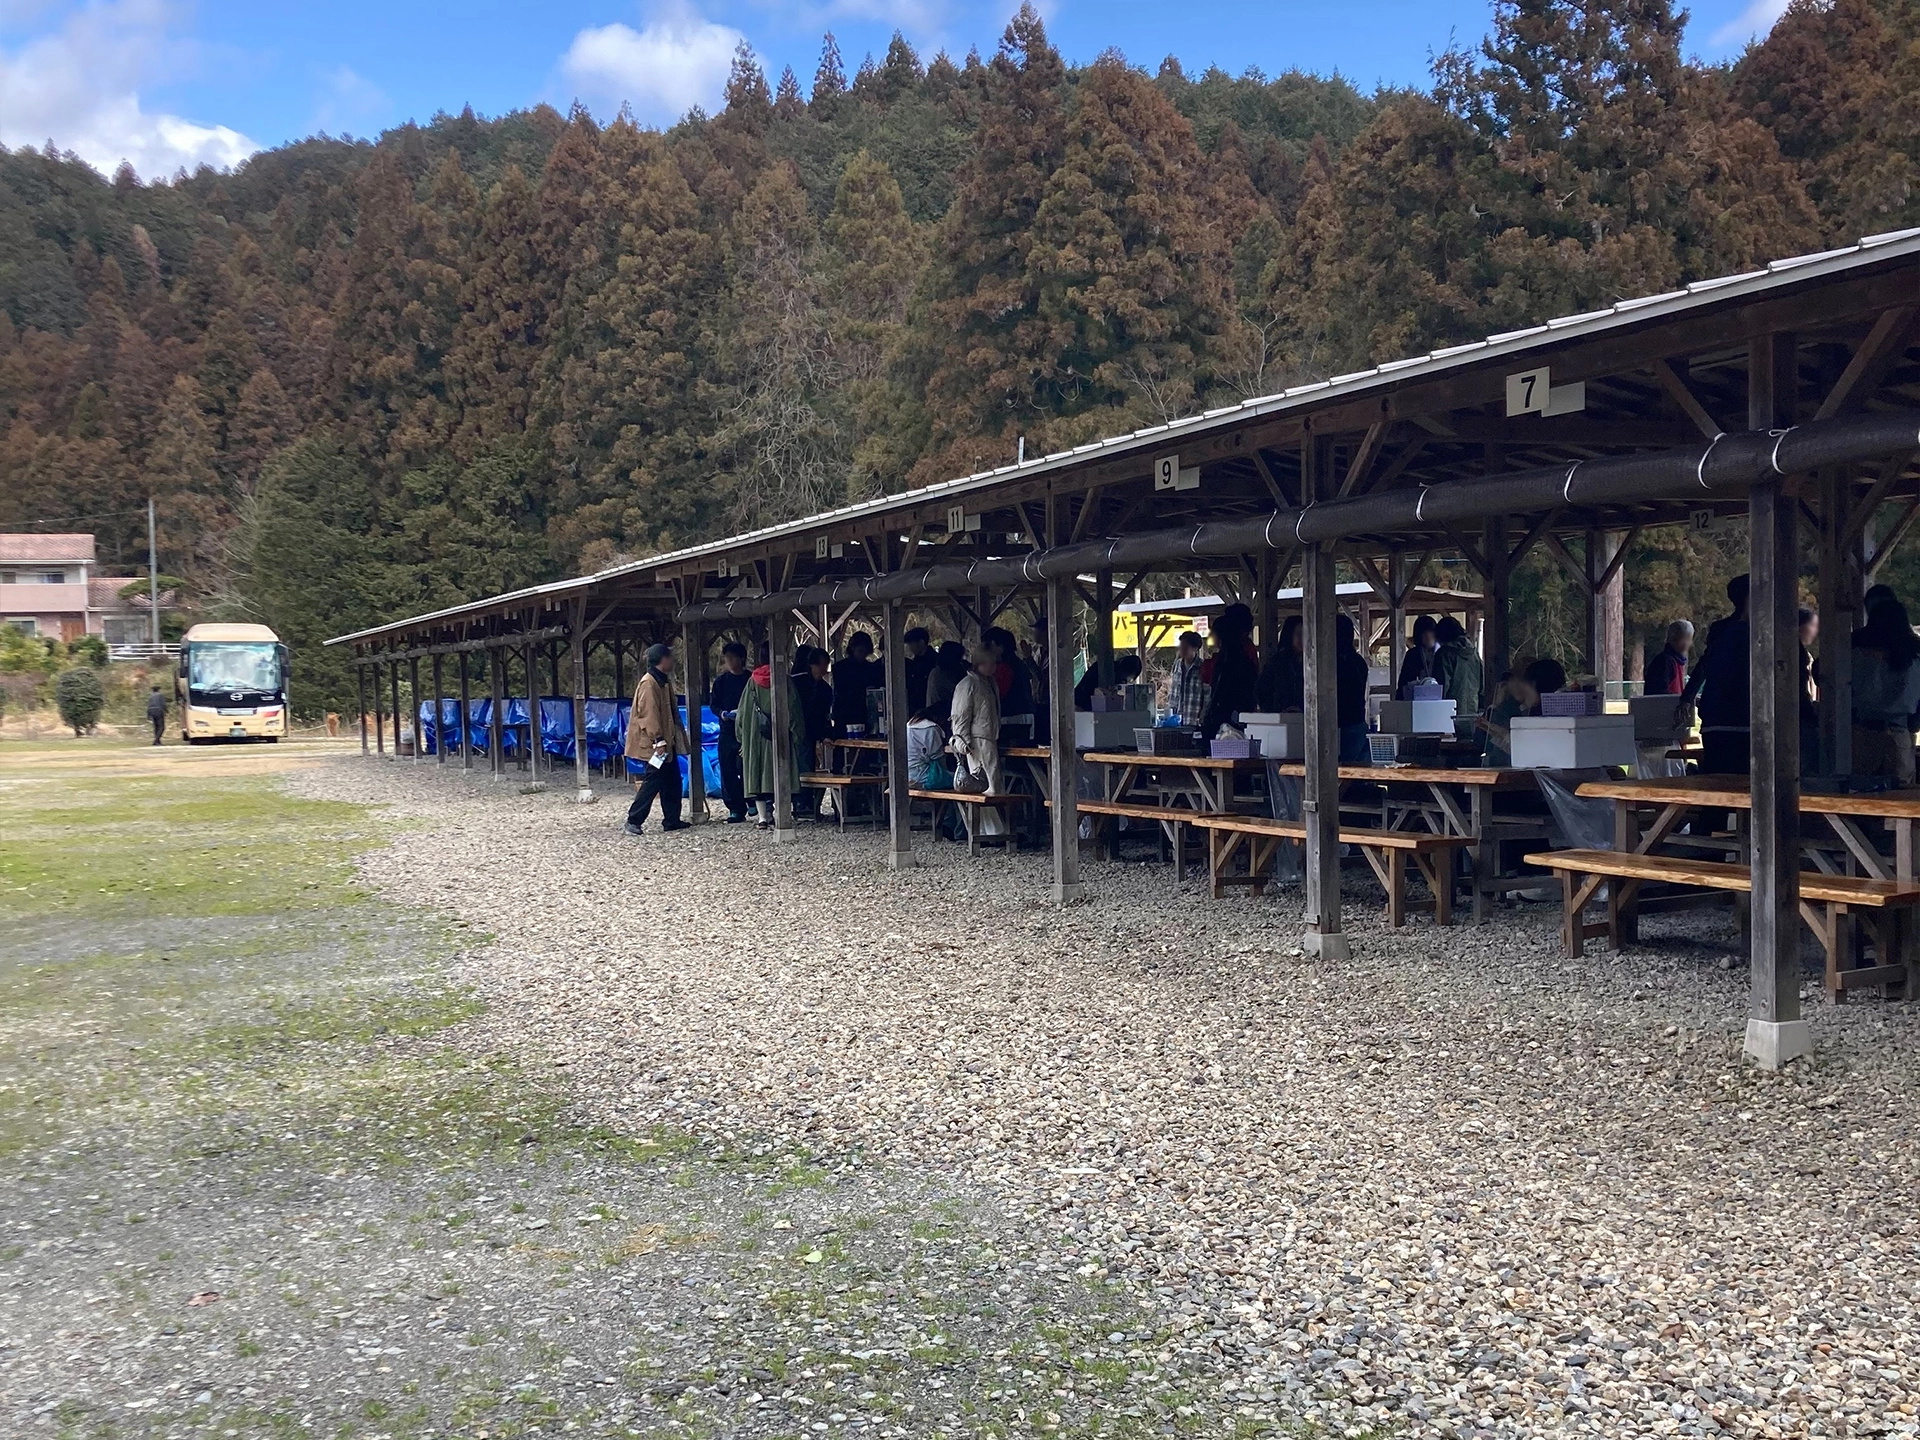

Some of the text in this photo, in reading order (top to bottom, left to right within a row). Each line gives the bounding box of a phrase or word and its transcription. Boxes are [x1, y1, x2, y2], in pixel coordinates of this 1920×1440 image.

[1521, 375, 1536, 409] 7
[1162, 461, 1171, 484] 9
[951, 510, 960, 530] 11
[1695, 512, 1708, 528] 12
